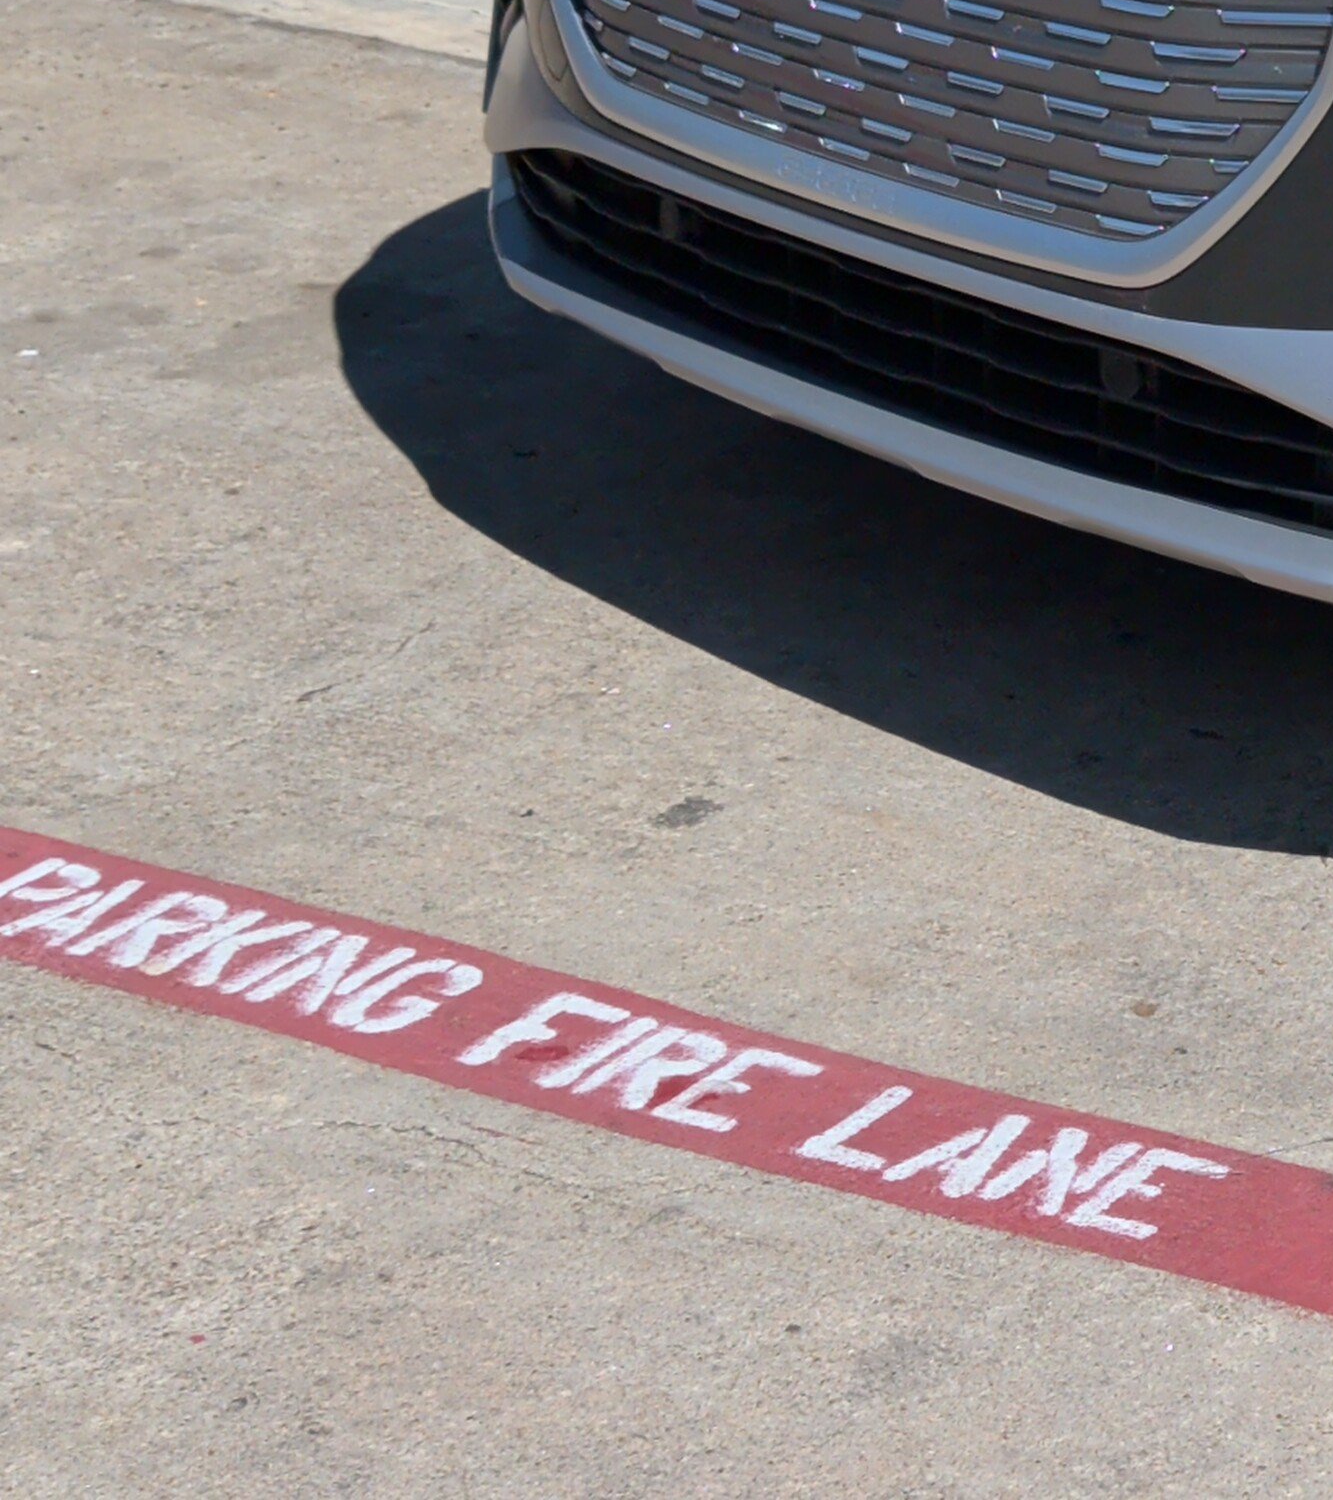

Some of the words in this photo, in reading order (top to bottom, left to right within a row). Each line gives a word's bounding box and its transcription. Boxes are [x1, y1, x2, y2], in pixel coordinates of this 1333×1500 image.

[0, 857, 484, 1034] PARKING
[456, 992, 824, 1132] FIRE
[796, 1085, 1230, 1239] LANE
